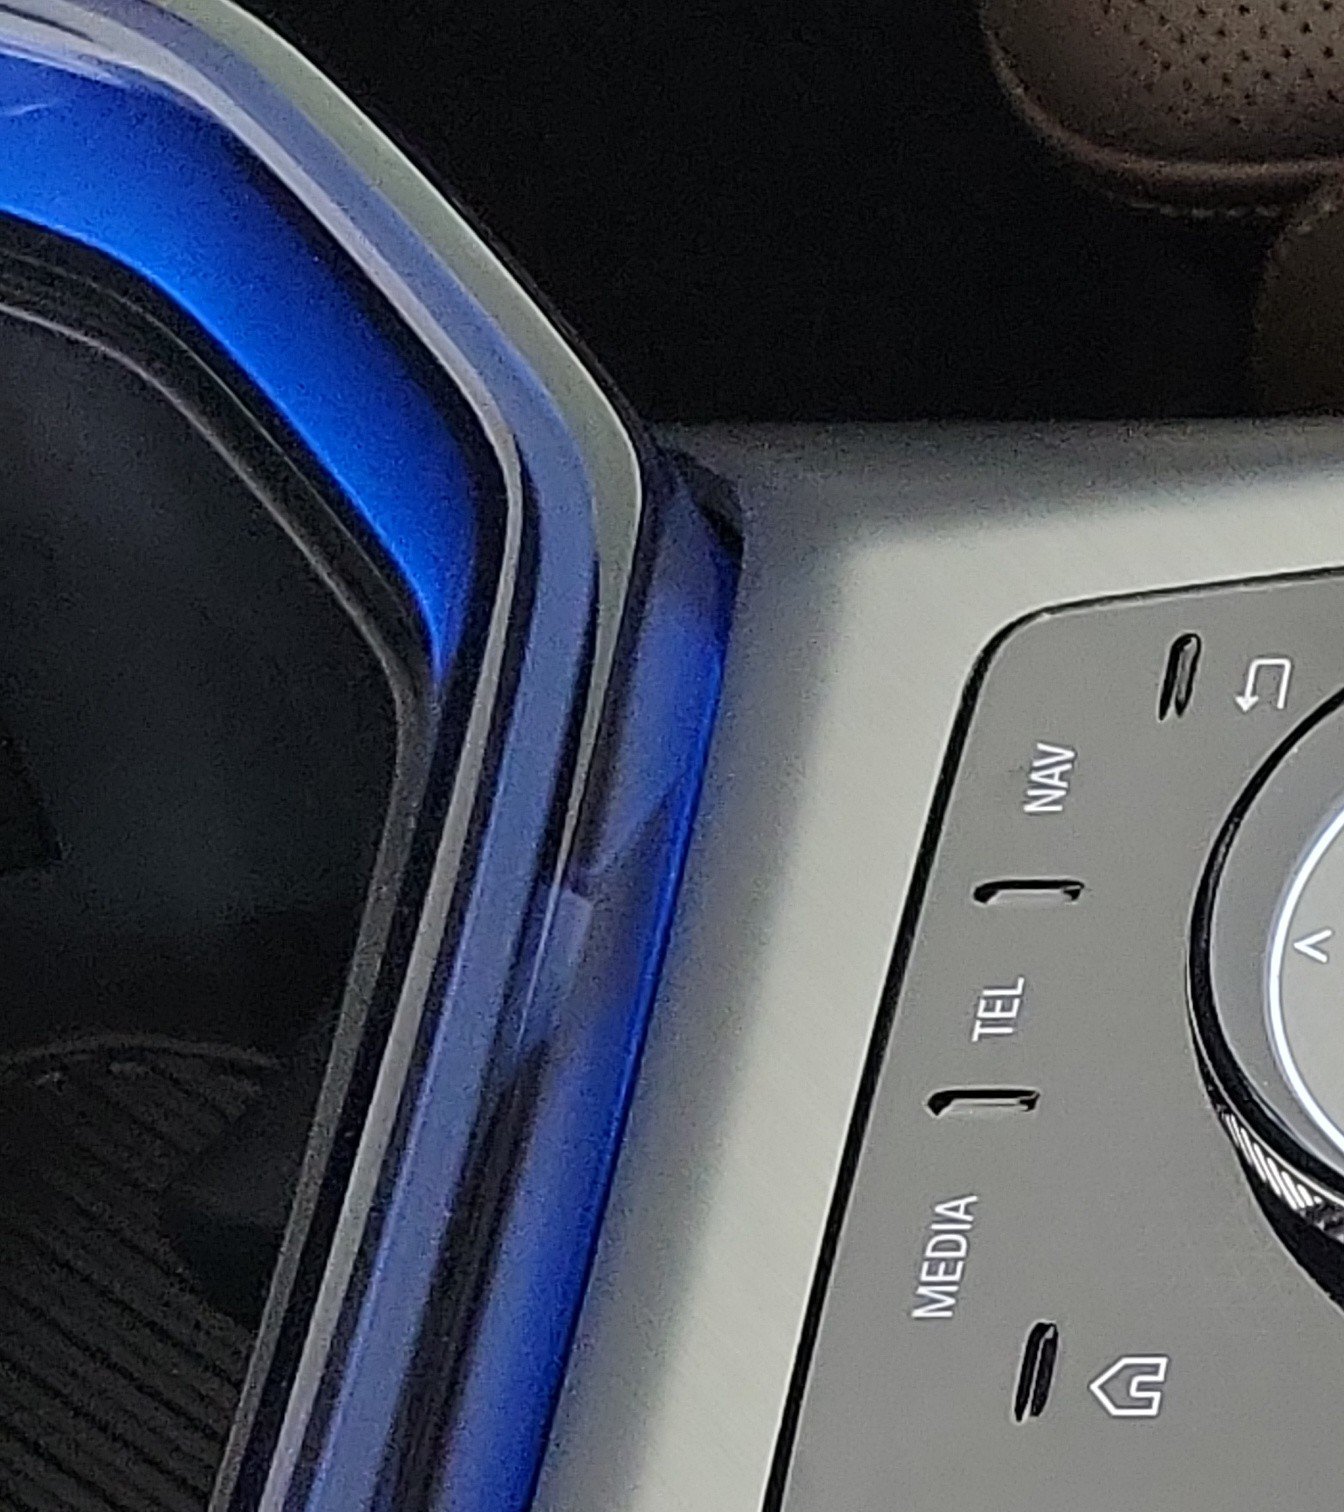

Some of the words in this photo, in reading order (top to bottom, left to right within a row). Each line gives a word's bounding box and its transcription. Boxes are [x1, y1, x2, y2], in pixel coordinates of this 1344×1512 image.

[1023, 742, 1077, 813] NAV
[973, 976, 1025, 1042] TEL
[912, 1195, 978, 1320] MEDIA
